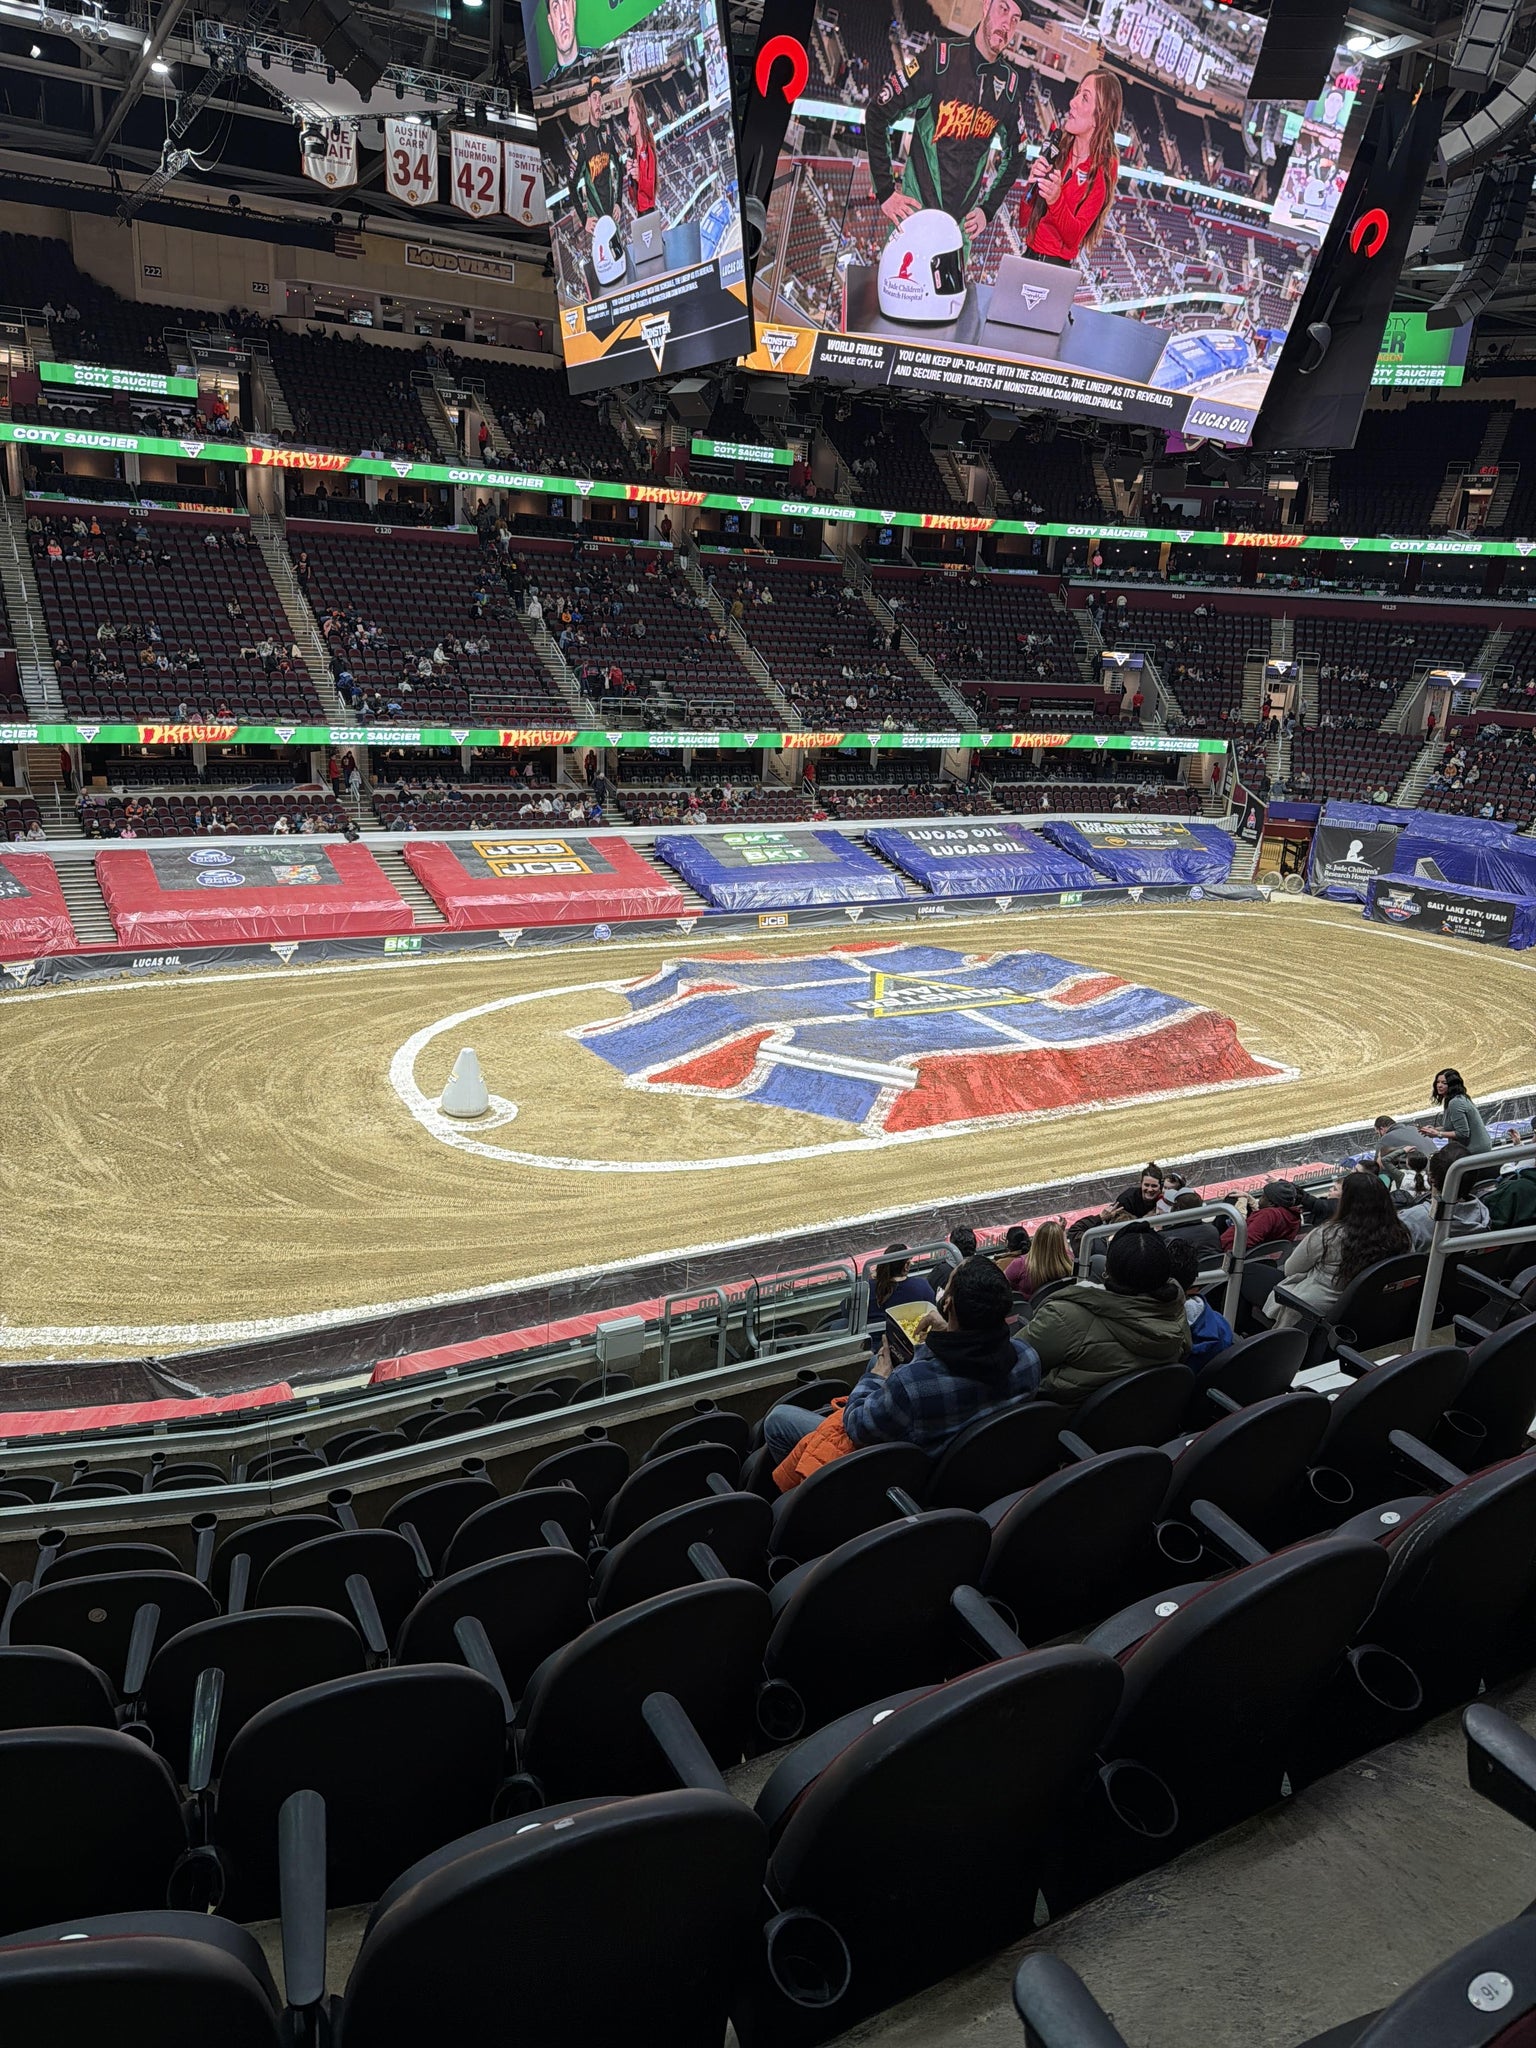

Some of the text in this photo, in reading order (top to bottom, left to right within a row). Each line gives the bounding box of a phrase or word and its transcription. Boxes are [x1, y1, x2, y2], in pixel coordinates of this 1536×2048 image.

[933, 98, 999, 143] DRAGON
[394, 125, 428, 140] AUSTIN
[399, 138, 424, 150] CARR
[464, 140, 487, 152] NATE
[454, 147, 498, 165] THURMOND
[393, 150, 431, 190] 34
[514, 160, 542, 174] SMITH
[457, 163, 494, 202] 42
[520, 175, 536, 209] 7
[407, 247, 512, 279] LOUDVILLE
[145, 266, 162, 277] 222
[253, 282, 269, 293] 223
[6, 326, 18, 334] 222
[641, 323, 671, 341] MONSTER
[761, 335, 797, 348] MONSTER
[827, 339, 883, 357] WORLD FINALS
[769, 345, 787, 354] JAM
[820, 353, 885, 369] SALT LAKE CITY, UT
[899, 350, 1173, 408] YOU CAN KEEP UP-TO-DATE WITH THE SCHEDULE, THE LINEUP AS ITS REVEALED,
[1395, 369, 1446, 377] SAUCIER
[74, 371, 167, 389] COTY SAUCIER
[1394, 378, 1445, 386] SAUCIER
[894, 365, 1123, 411] AND SECURE YOUR TICKETS AT MONSTERJAM.COM/WORLDFINALS.
[1191, 410, 1250, 433] LUCAS OIL
[13, 427, 138, 449] COTY SAUCIER
[713, 446, 774, 459] COTY SAUCIER
[448, 469, 544, 488] COTY SAUCIER
[135, 509, 149, 517] 119
[781, 503, 856, 519] COTY SAUCIER
[1066, 526, 1148, 539] COTY SAUCIER
[1390, 541, 1482, 553] COTY SAUCIER
[0, 729, 38, 739] CIER
[138, 725, 238, 743] DRAGON
[329, 731, 421, 741] COTY SAUCIER
[499, 730, 578, 747] DRAGON
[649, 736, 720, 745] COTY SAUCIER
[902, 737, 961, 745] COTY SAUCIER
[1130, 740, 1199, 750] COTY SAUCIER
[909, 826, 1000, 841] LUCAS OIL
[486, 844, 565, 856] JCB
[745, 849, 803, 861] BKT
[932, 842, 1024, 856] LUCAS OIL
[501, 861, 582, 875] JCB
[1333, 864, 1347, 874] Jude
[1348, 865, 1378, 875] Children's
[1324, 870, 1369, 881] Research Hospi
[918, 905, 945, 914] LUCAS OIL
[1379, 899, 1397, 908] WORLD
[1402, 903, 1420, 913] FINALS
[1427, 901, 1507, 922] SALT LAKE CITY, UTAH
[762, 917, 785, 926] JCB
[1447, 915, 1463, 923] JULY
[1464, 917, 1470, 925] 2
[385, 938, 421, 949] BKT
[133, 956, 181, 968] LUCAS OIL
